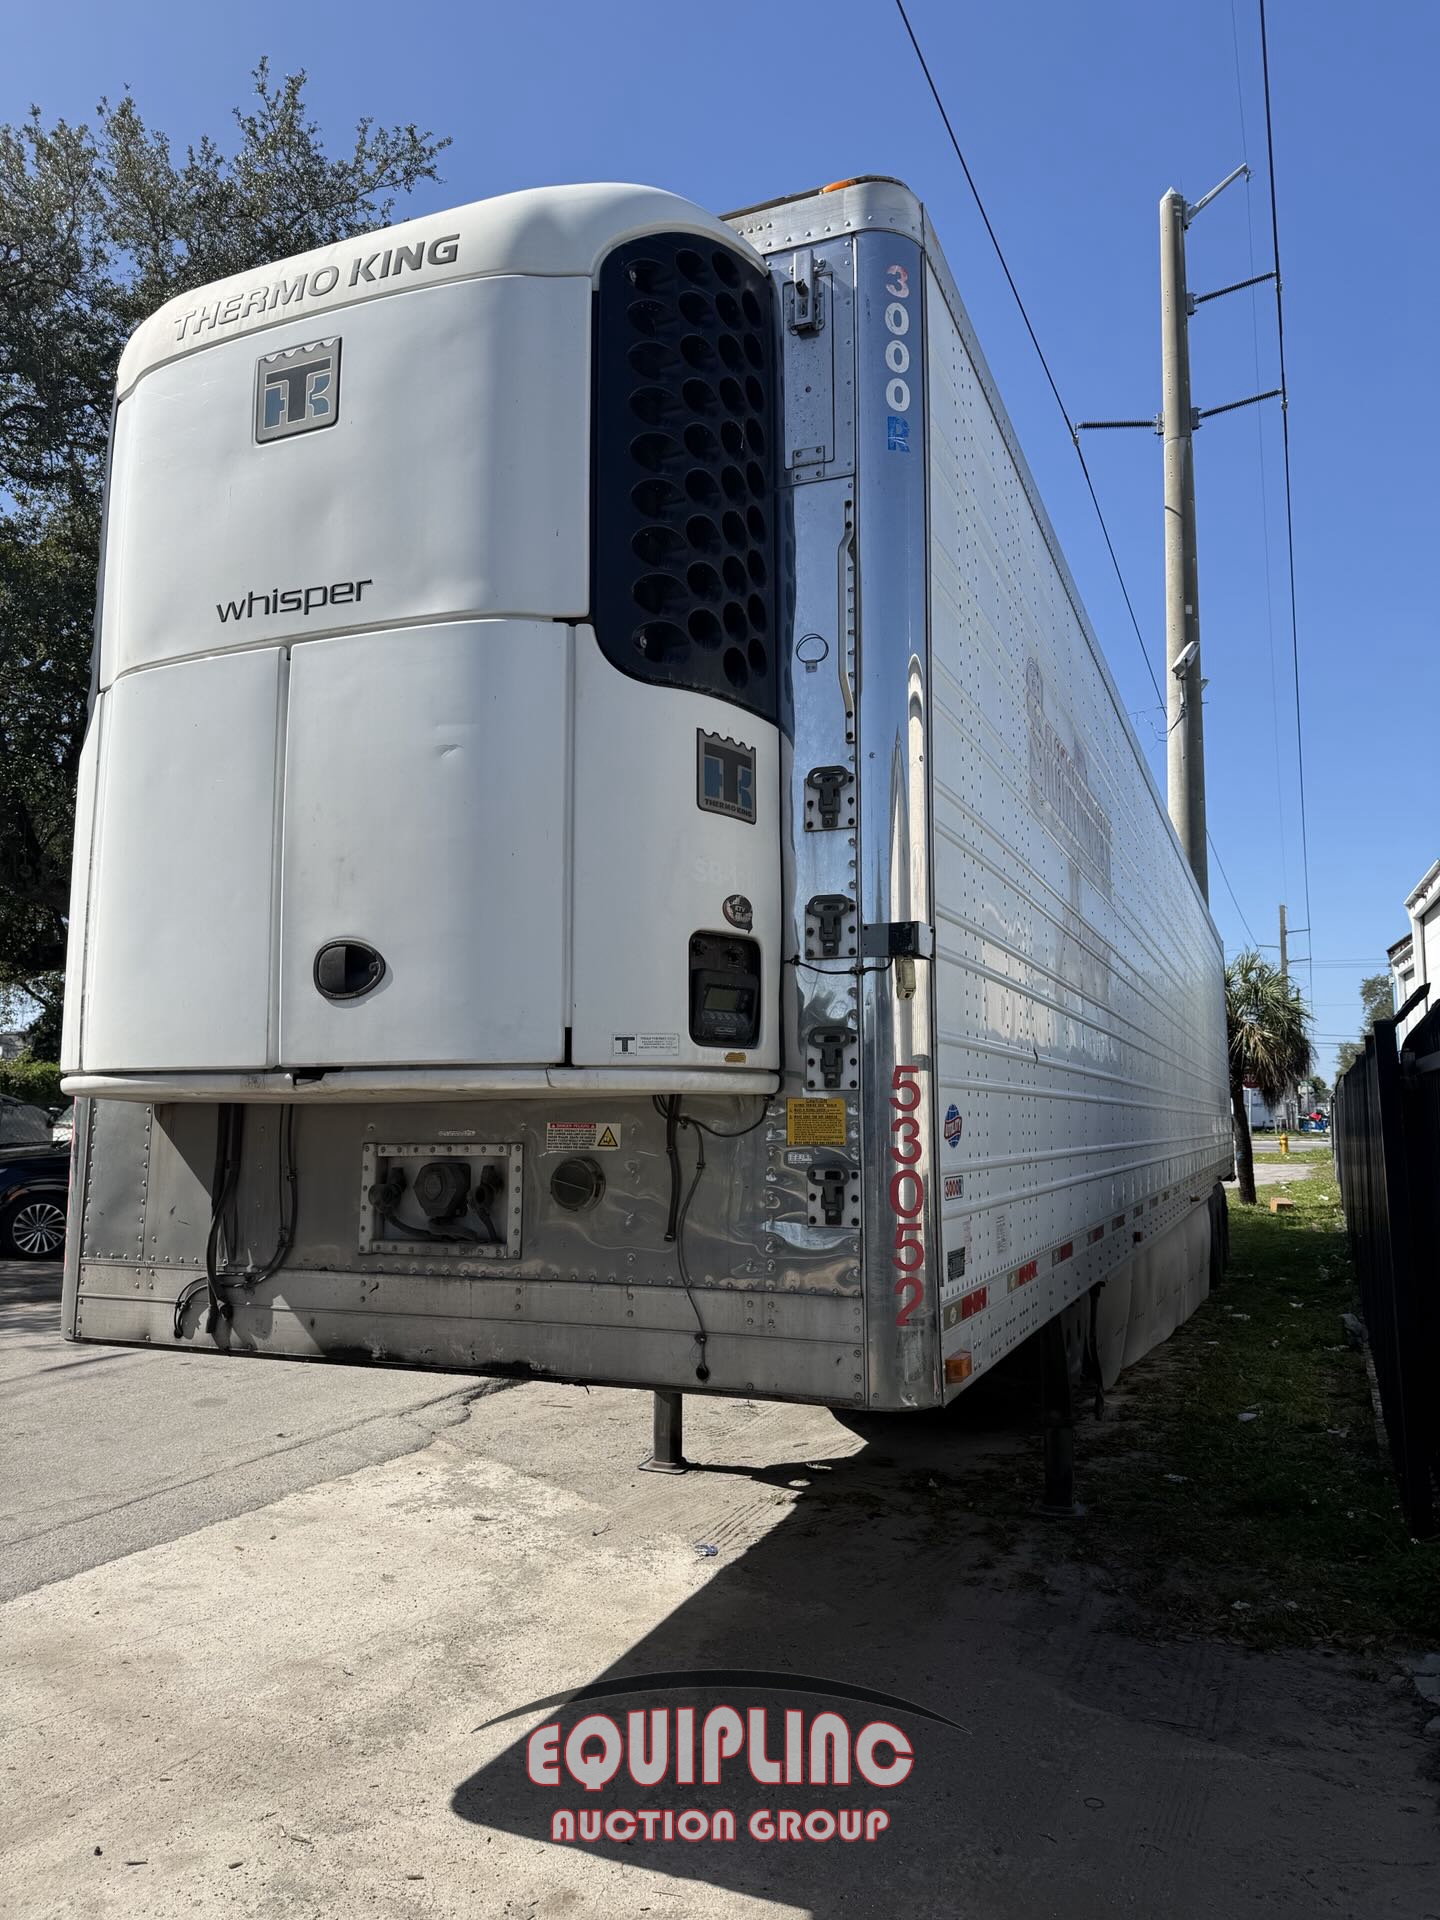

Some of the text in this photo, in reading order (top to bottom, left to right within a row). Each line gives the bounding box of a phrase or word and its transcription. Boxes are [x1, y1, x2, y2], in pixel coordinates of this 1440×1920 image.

[174, 233, 460, 340] THERMO KING
[215, 579, 373, 622] whisper
[704, 799, 737, 813] THERMO
[889, 1065, 924, 1327] 53052
